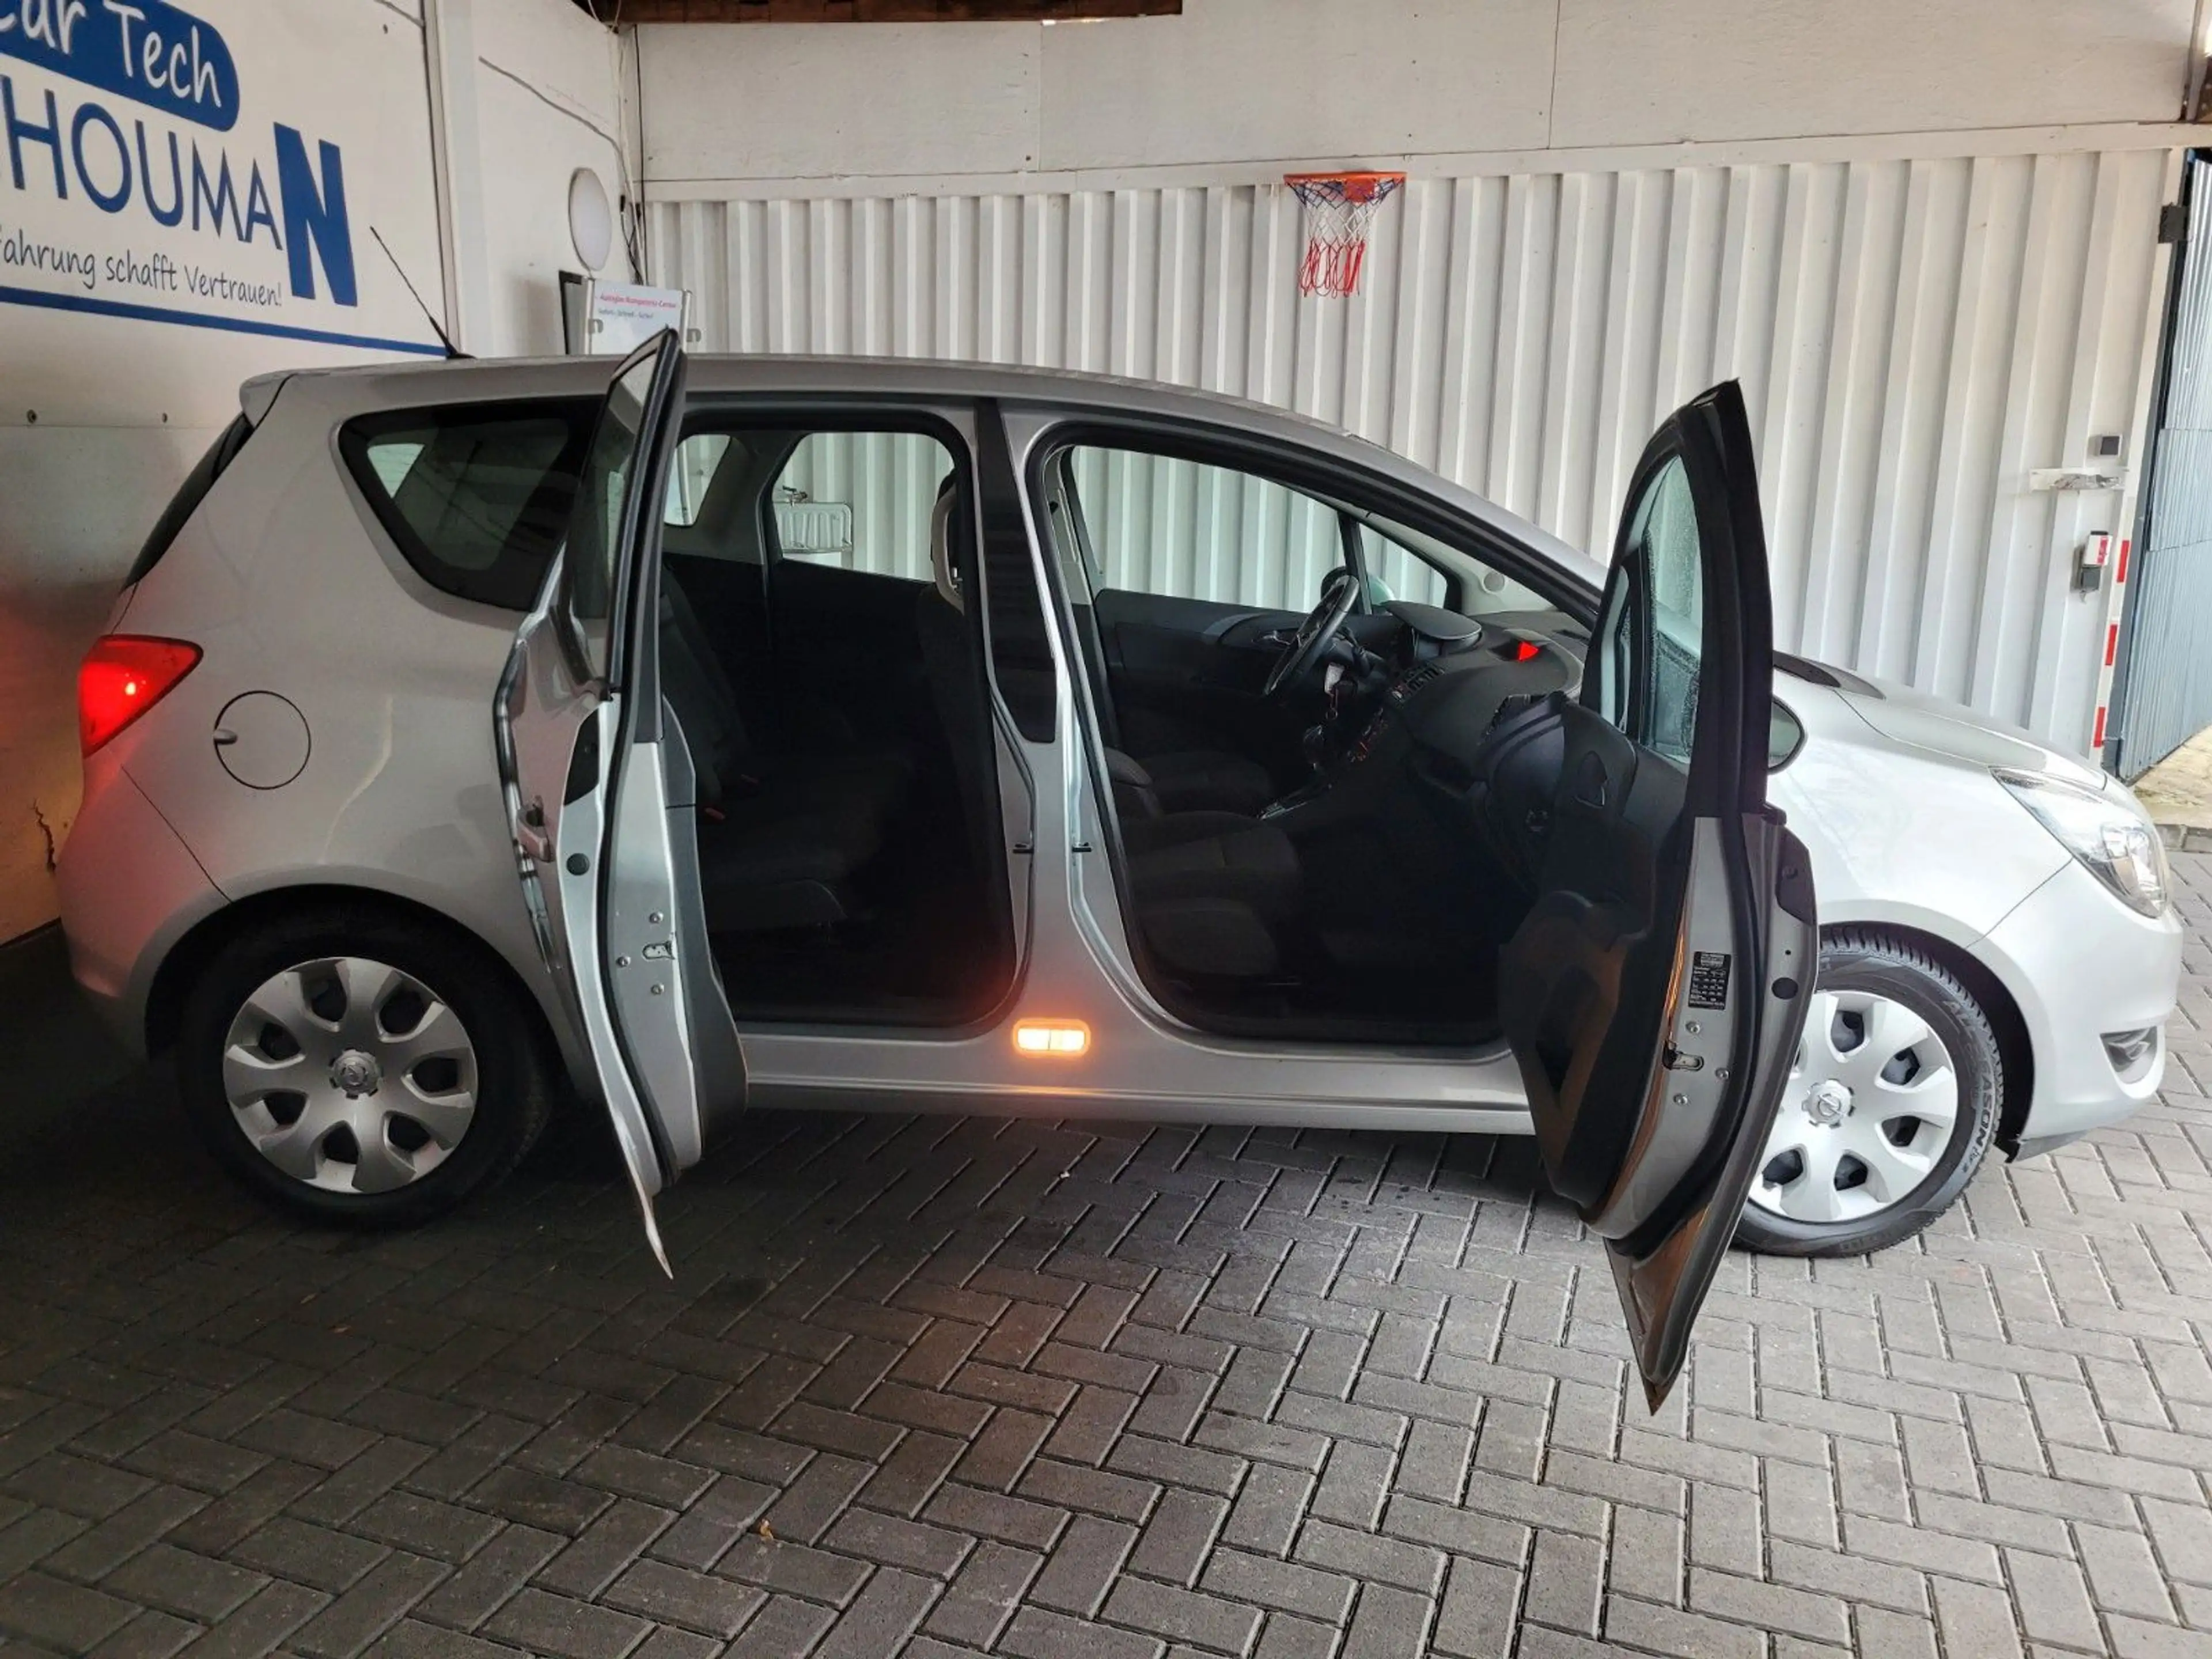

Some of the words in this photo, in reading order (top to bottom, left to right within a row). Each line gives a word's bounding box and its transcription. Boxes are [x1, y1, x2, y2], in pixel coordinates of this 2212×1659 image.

[104, 2, 222, 109] Tech
[0, 225, 96, 289] ahrung
[106, 254, 177, 291] schafft
[184, 264, 281, 307] Vertrauen!
